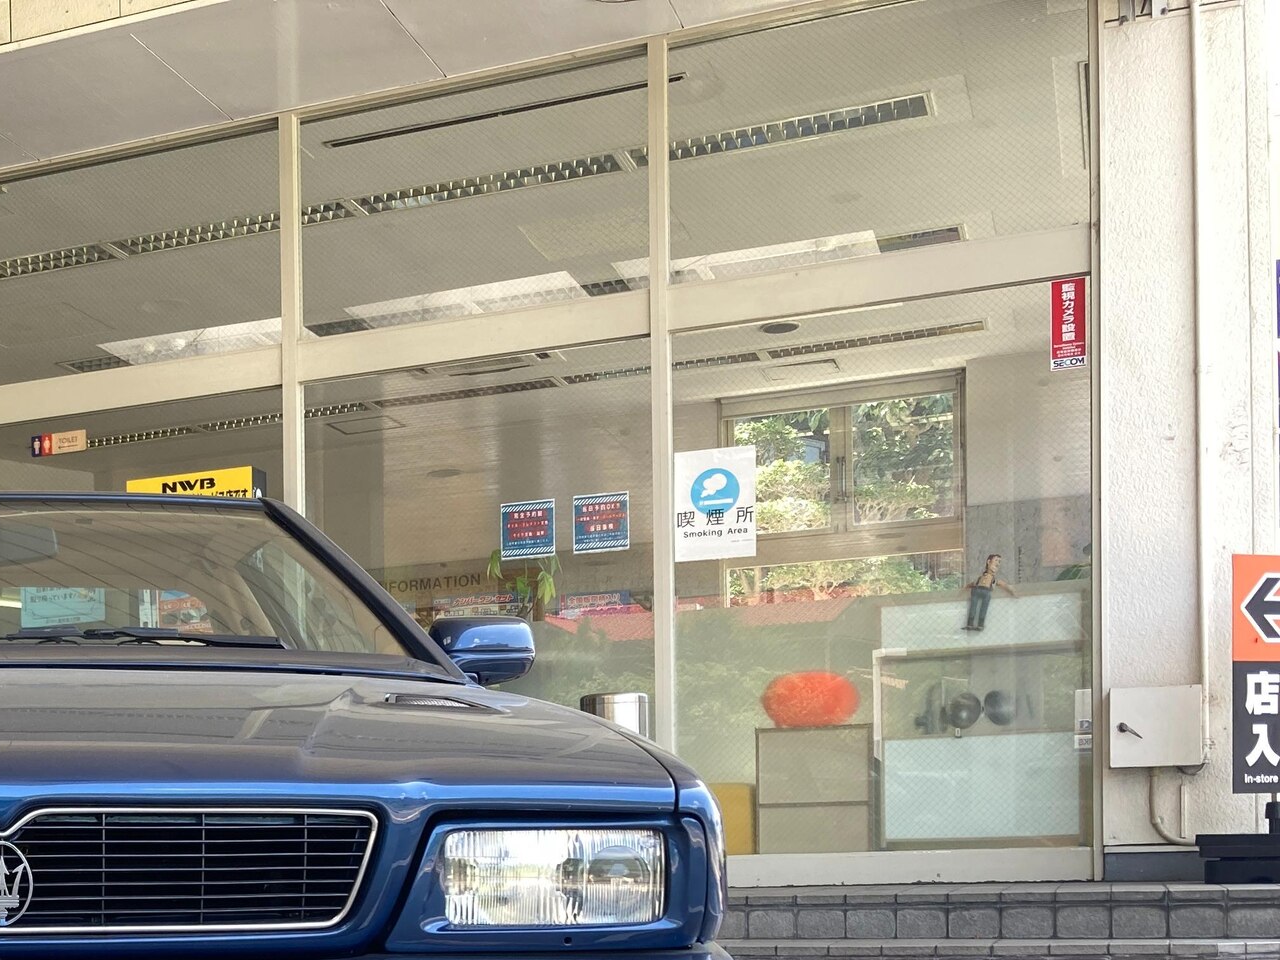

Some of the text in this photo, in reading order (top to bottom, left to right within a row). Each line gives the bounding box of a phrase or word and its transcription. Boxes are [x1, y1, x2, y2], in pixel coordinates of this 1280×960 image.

[1053, 357, 1084, 367] SECOM
[161, 478, 216, 494] NWB
[676, 505, 754, 528] 喫煙所
[683, 529, 723, 538] Smoking
[378, 574, 481, 593] NFORMATION
[1245, 671, 1280, 715] 店
[1245, 723, 1280, 767] 入
[1244, 773, 1279, 784] In-store
